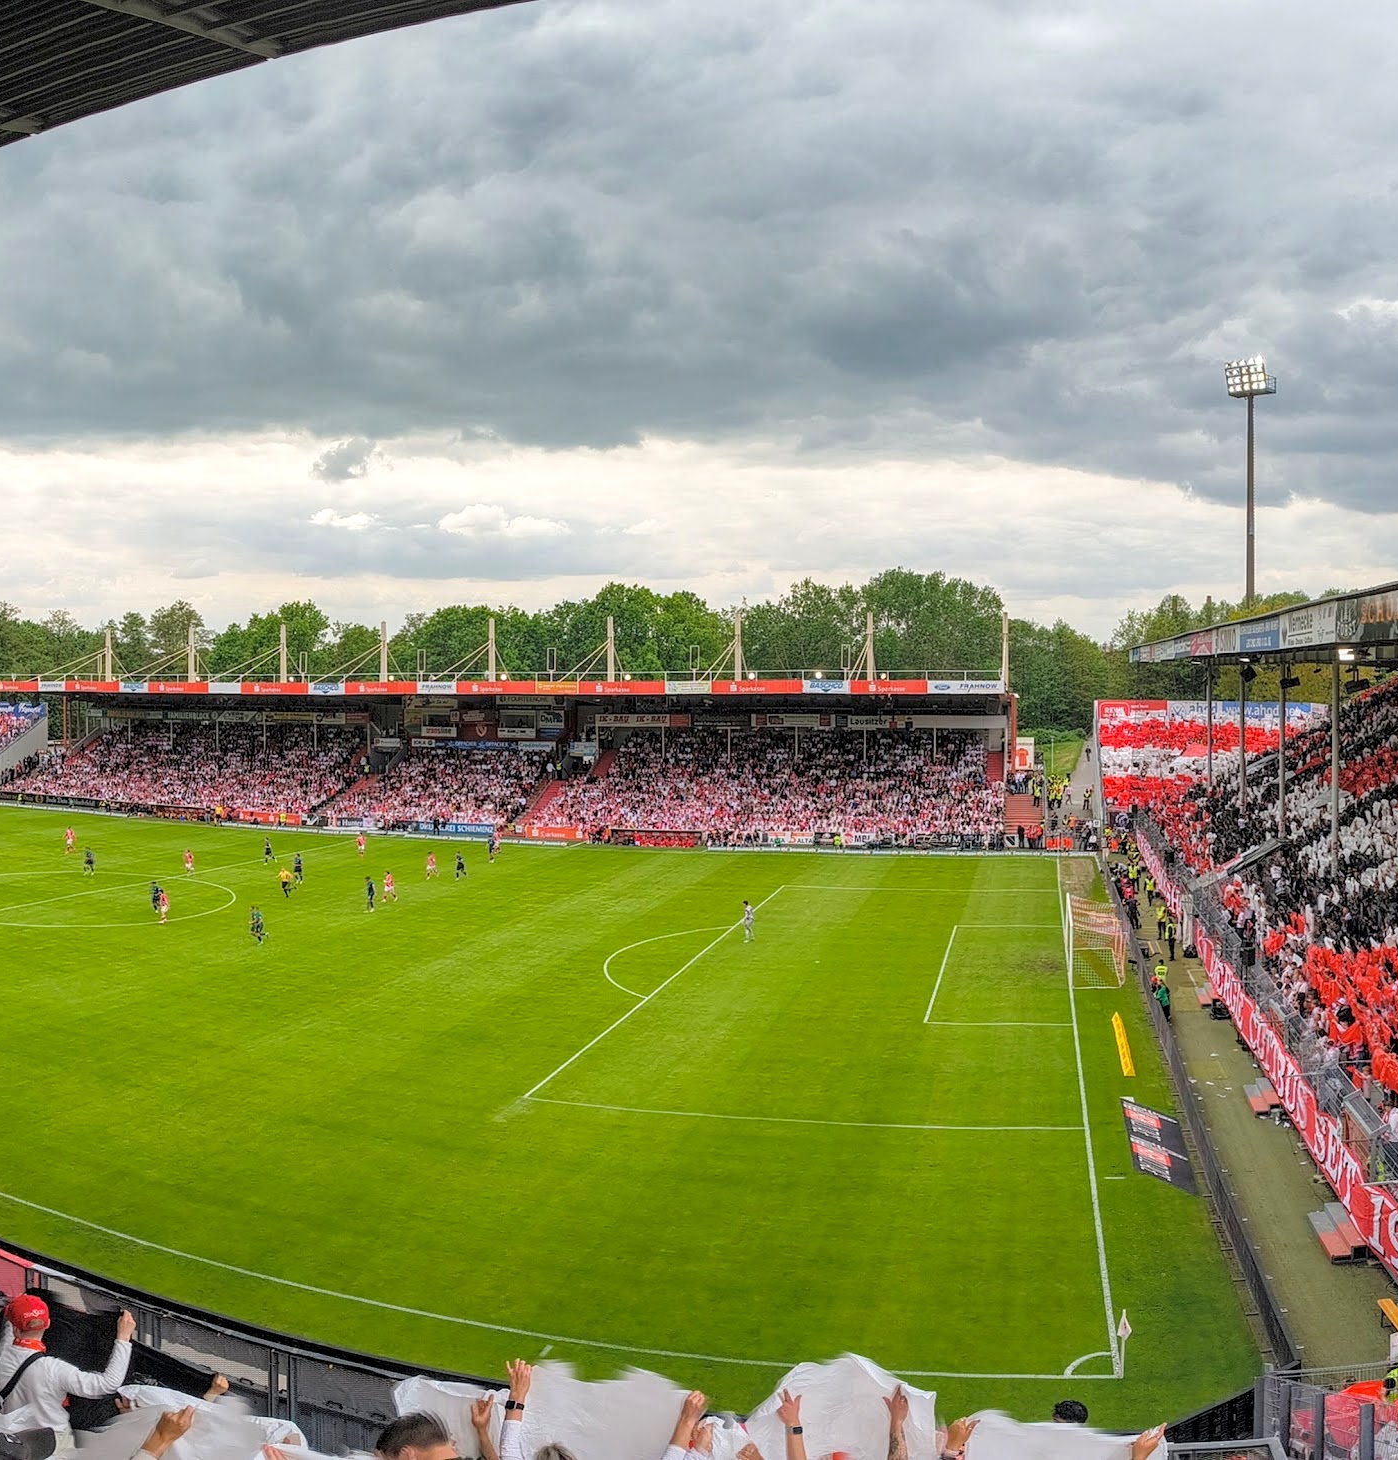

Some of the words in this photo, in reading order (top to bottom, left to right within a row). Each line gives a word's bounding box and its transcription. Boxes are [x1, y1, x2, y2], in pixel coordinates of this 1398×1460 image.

[1337, 620, 1356, 636] FORST
[421, 683, 452, 692] FRAHNOW
[959, 683, 998, 692] FRAHNOW
[1226, 703, 1300, 717] www.ahodnet
[850, 717, 887, 725] Lausitzer
[342, 818, 363, 827] Hunter
[457, 825, 494, 833] SCHIEMENZ
[1313, 1115, 1363, 1207] SEIT
